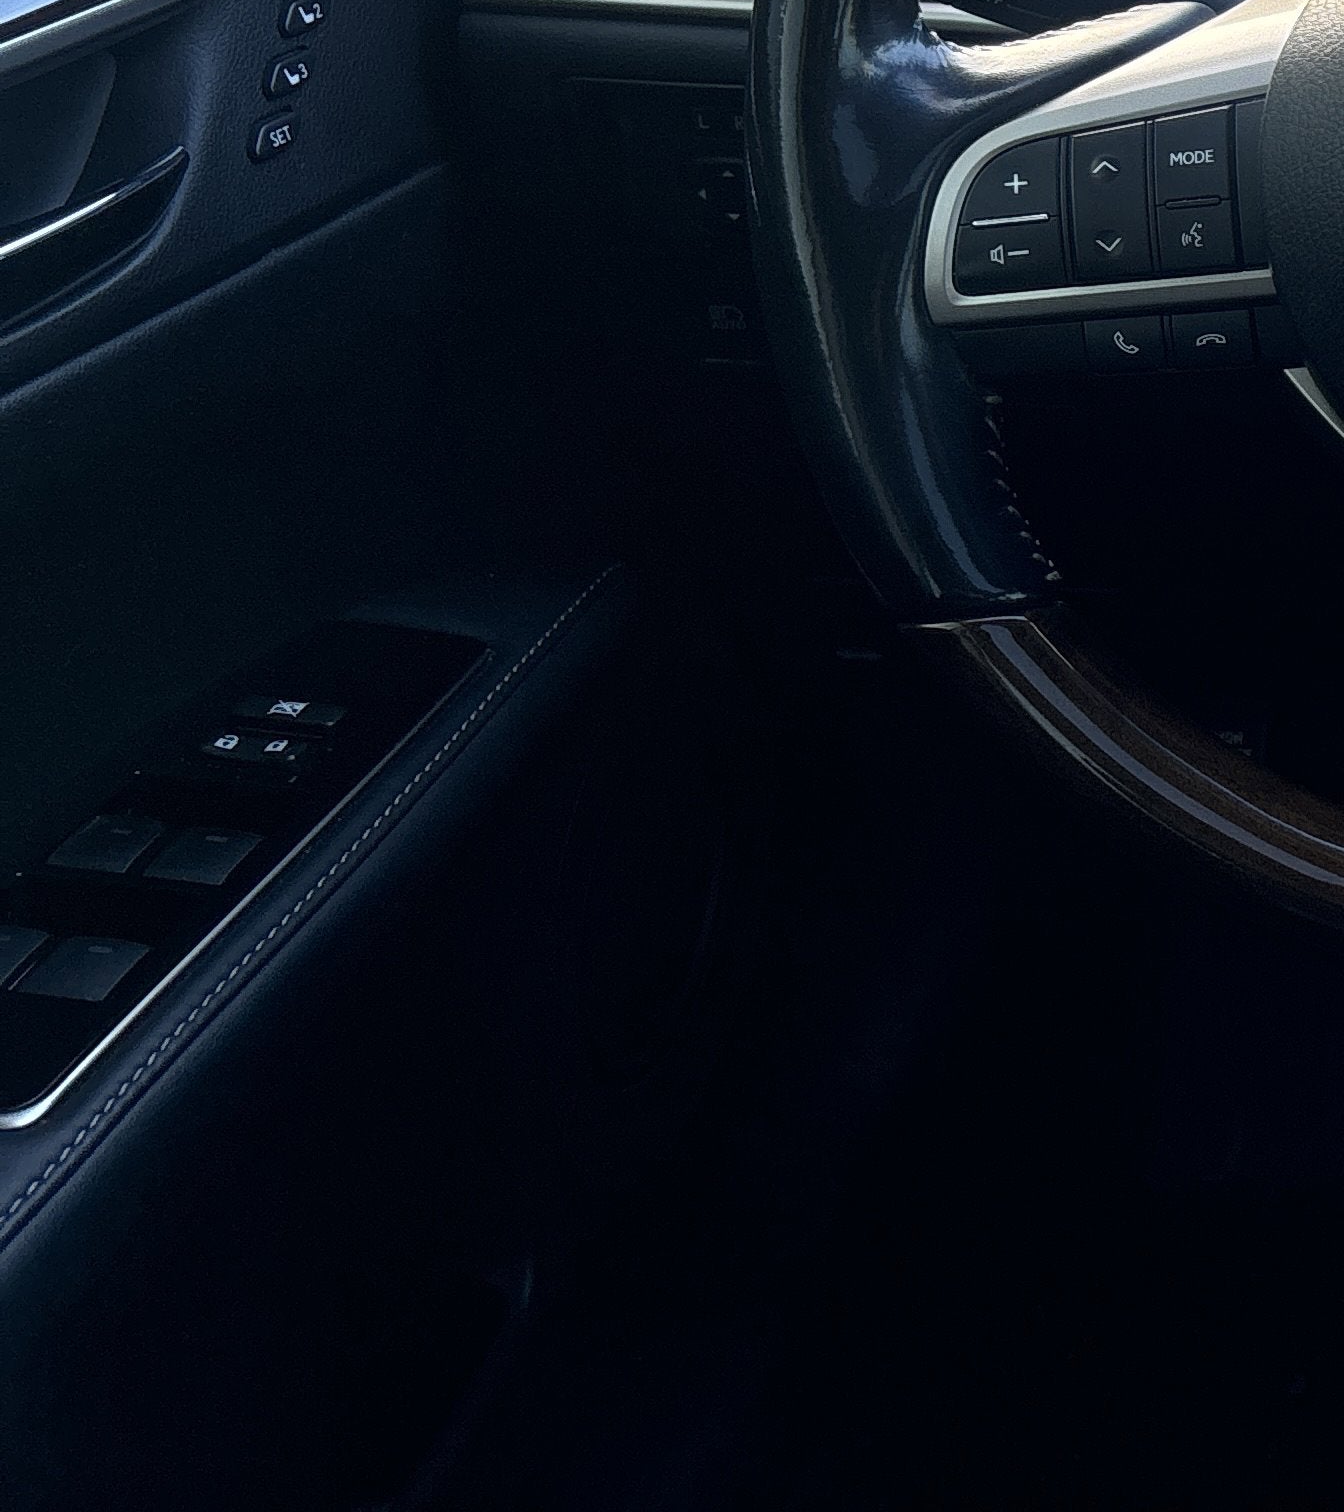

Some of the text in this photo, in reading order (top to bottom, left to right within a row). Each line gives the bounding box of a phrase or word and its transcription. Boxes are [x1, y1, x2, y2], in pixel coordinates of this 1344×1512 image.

[313, 3, 324, 19] 2
[297, 63, 308, 79] 3
[269, 125, 292, 148] SET
[1170, 148, 1215, 167] MODE
